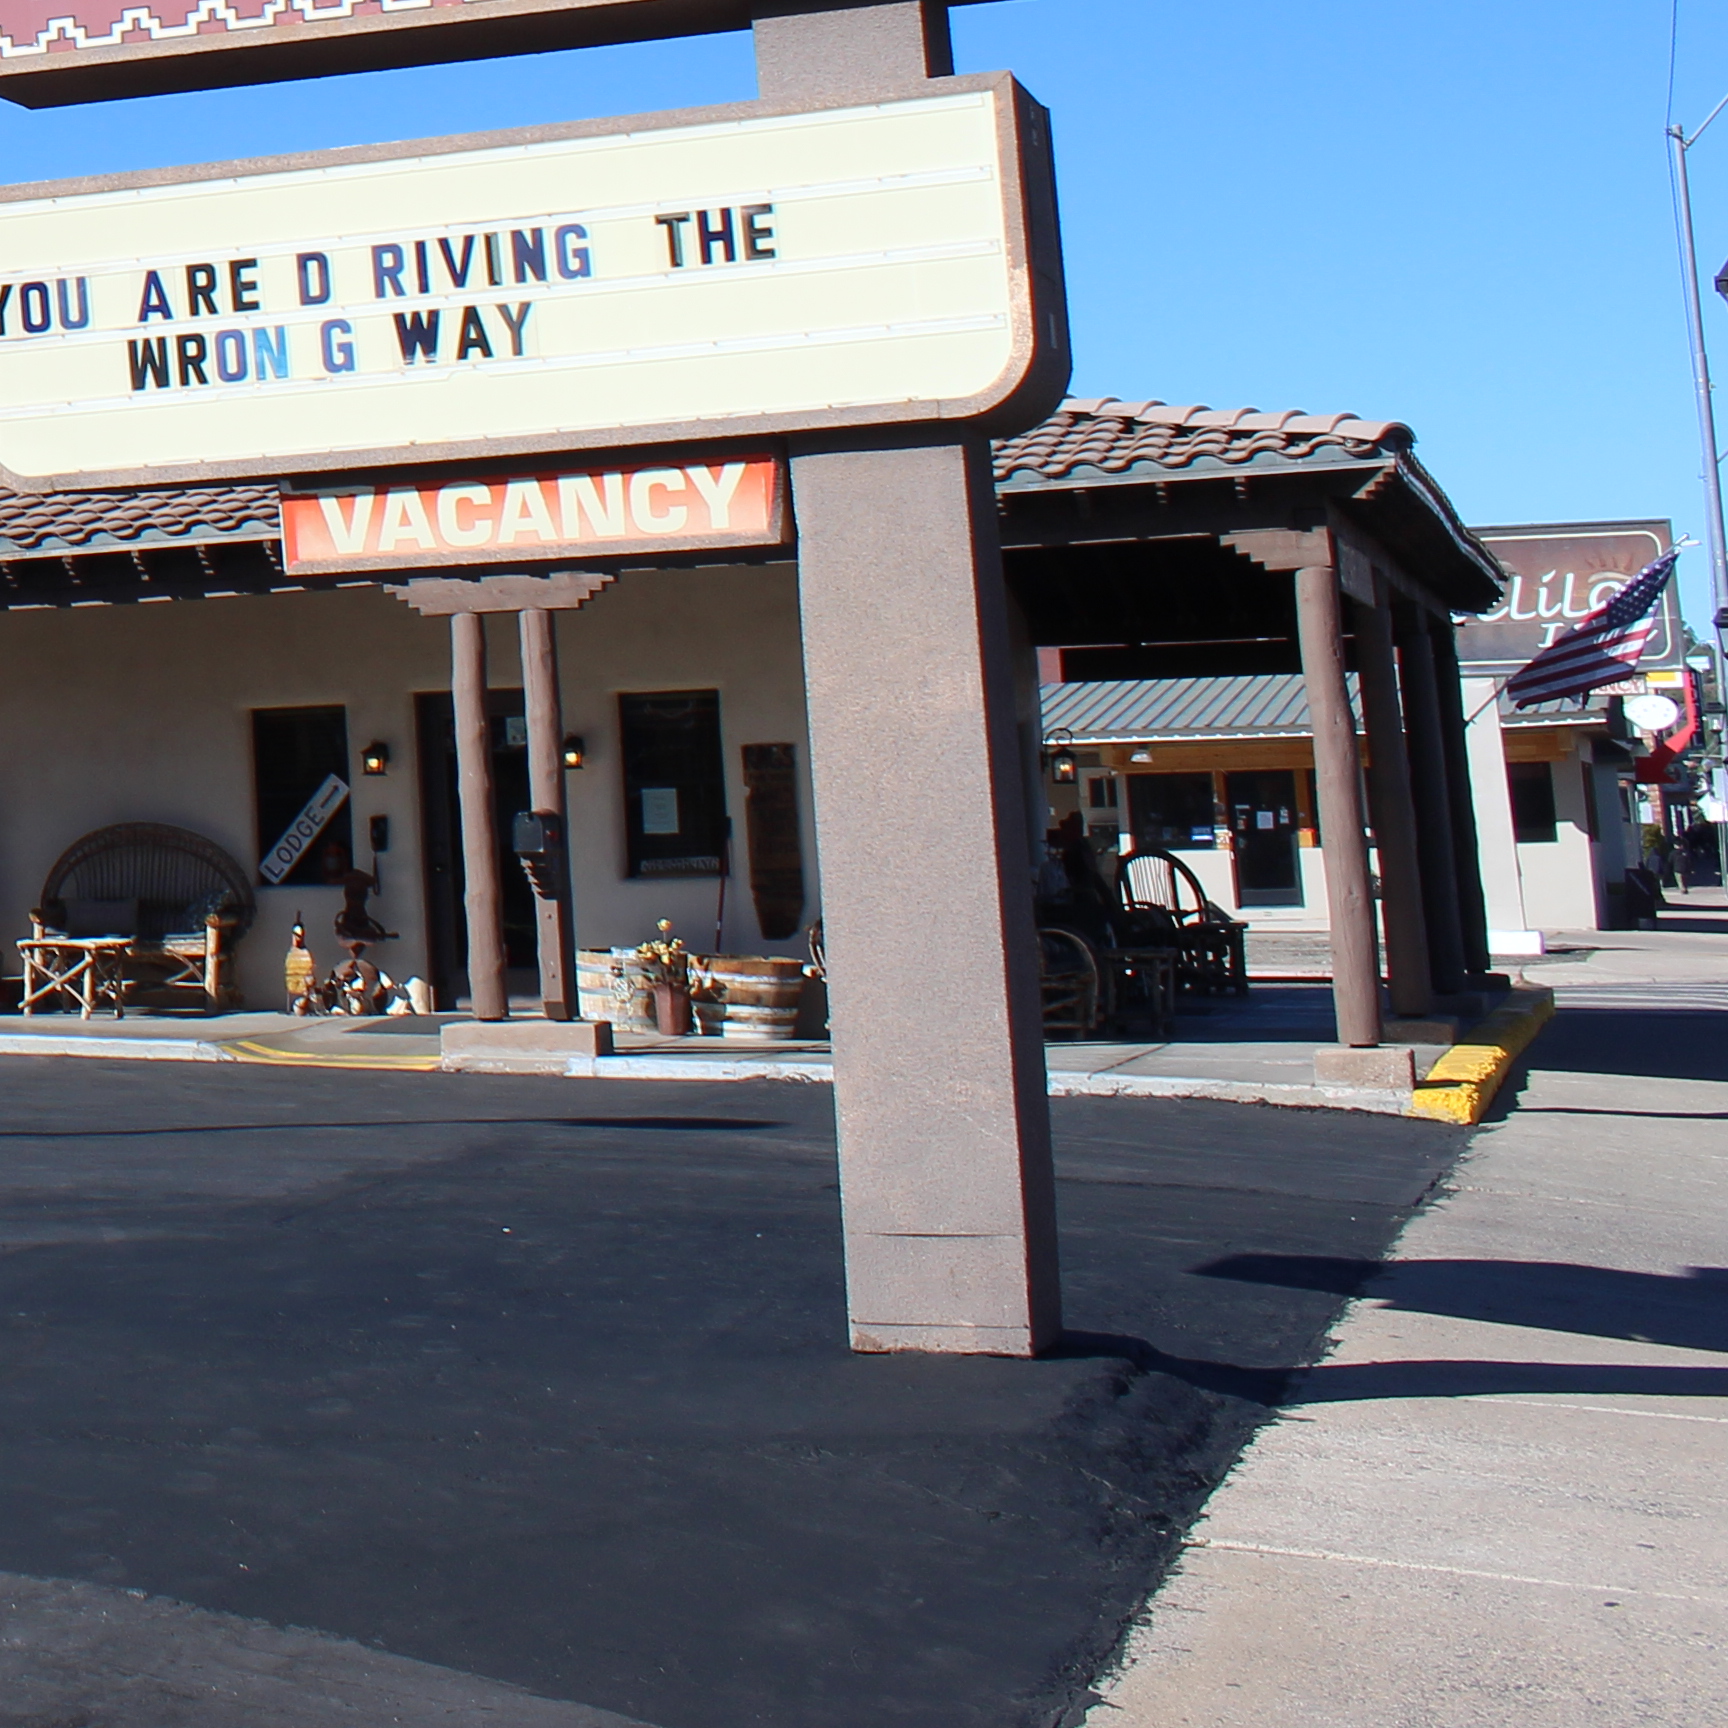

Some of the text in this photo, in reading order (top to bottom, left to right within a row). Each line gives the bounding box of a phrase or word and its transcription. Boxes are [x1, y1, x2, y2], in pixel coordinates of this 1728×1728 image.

[138, 257, 261, 322] ARE
[655, 203, 776, 268] THE
[392, 300, 533, 366] WAY
[317, 461, 747, 555] VACANCY
[264, 805, 326, 879] LODGE
